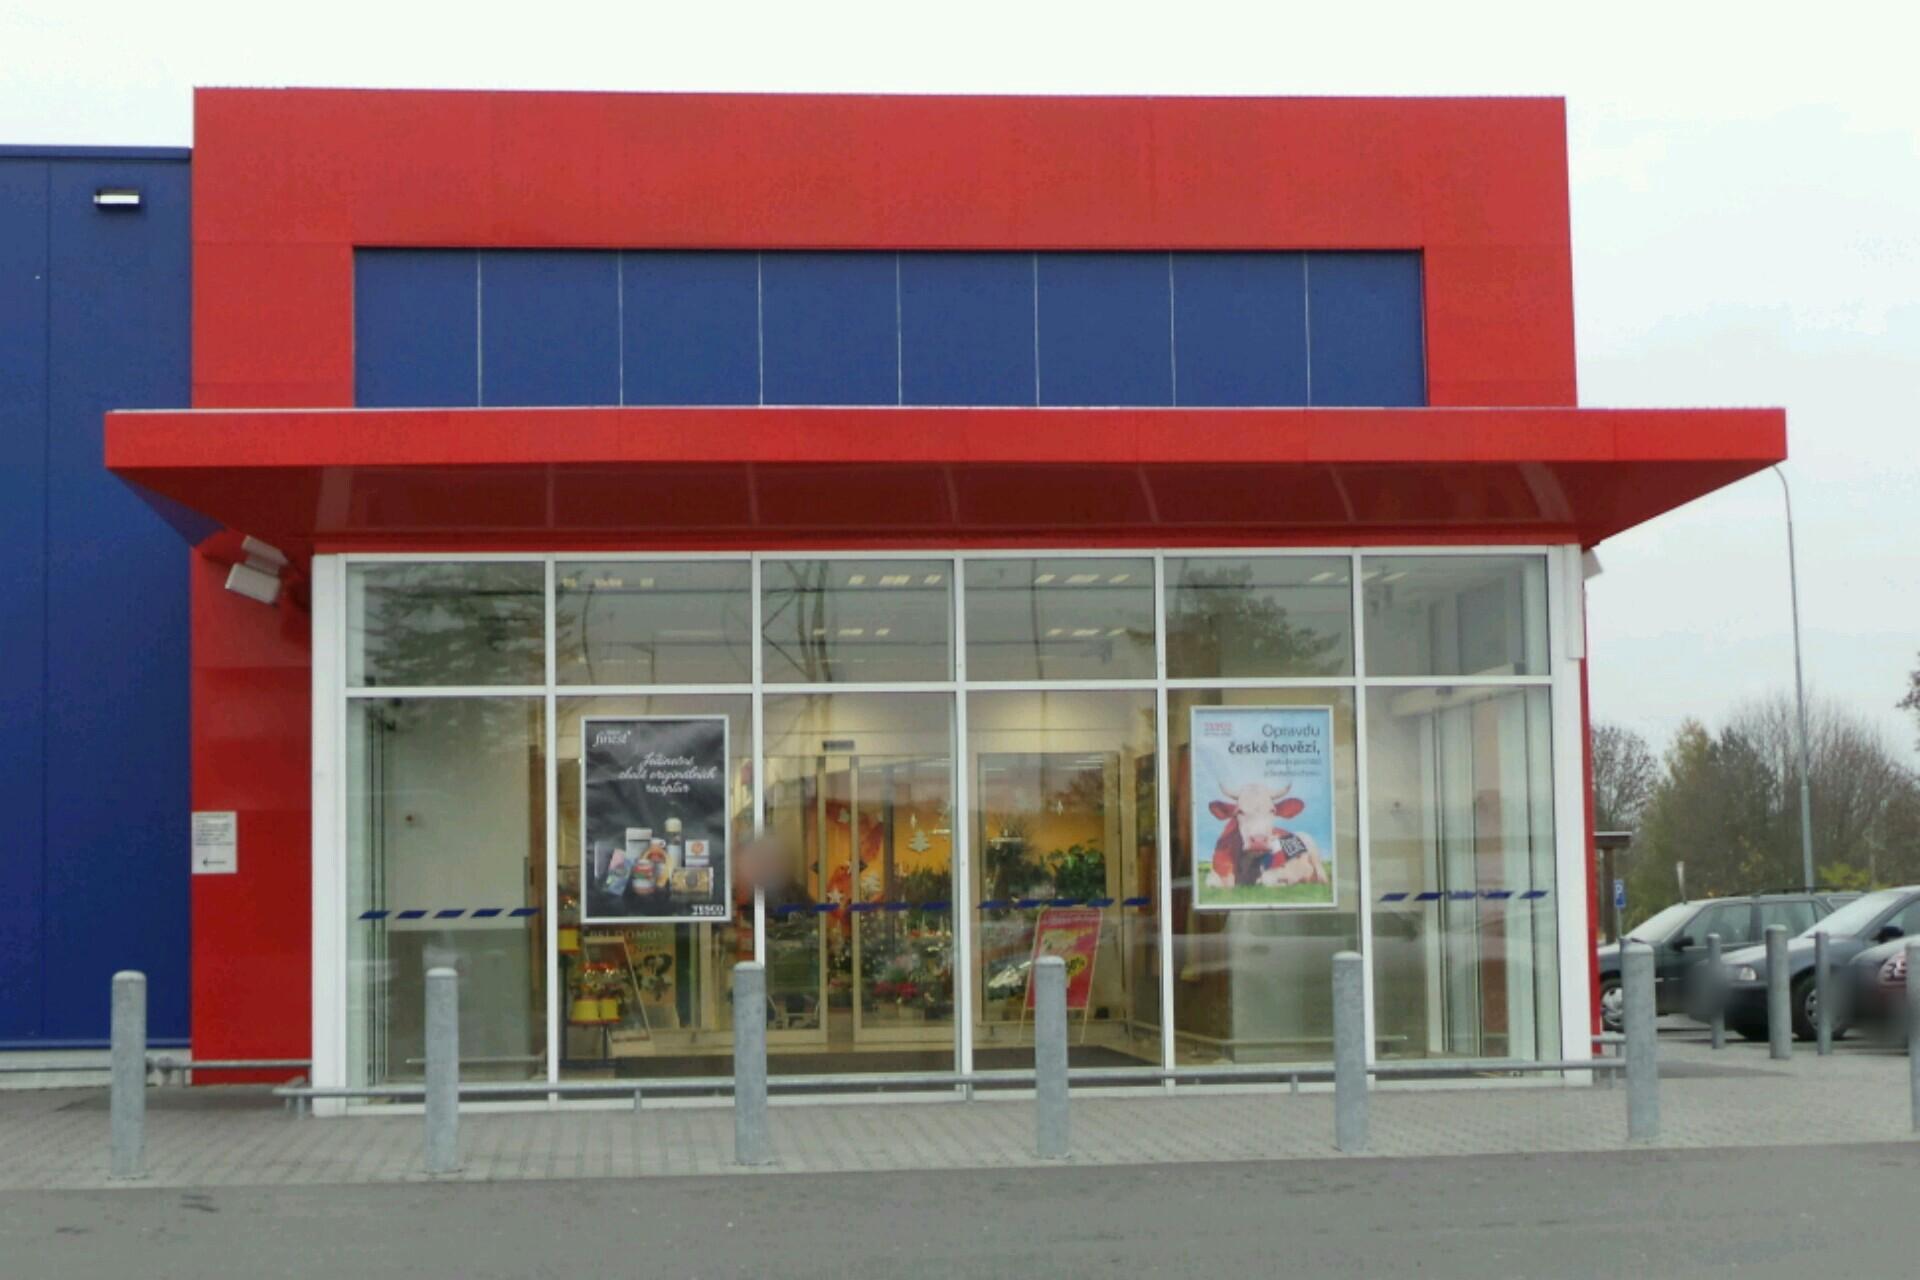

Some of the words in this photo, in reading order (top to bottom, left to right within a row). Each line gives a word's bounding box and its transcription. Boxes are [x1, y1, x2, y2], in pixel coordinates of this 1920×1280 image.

[1262, 723, 1320, 739] Opravdu
[1228, 740, 1268, 755] české
[1271, 740, 1321, 755] hovězí,
[691, 903, 724, 914] TESCO
